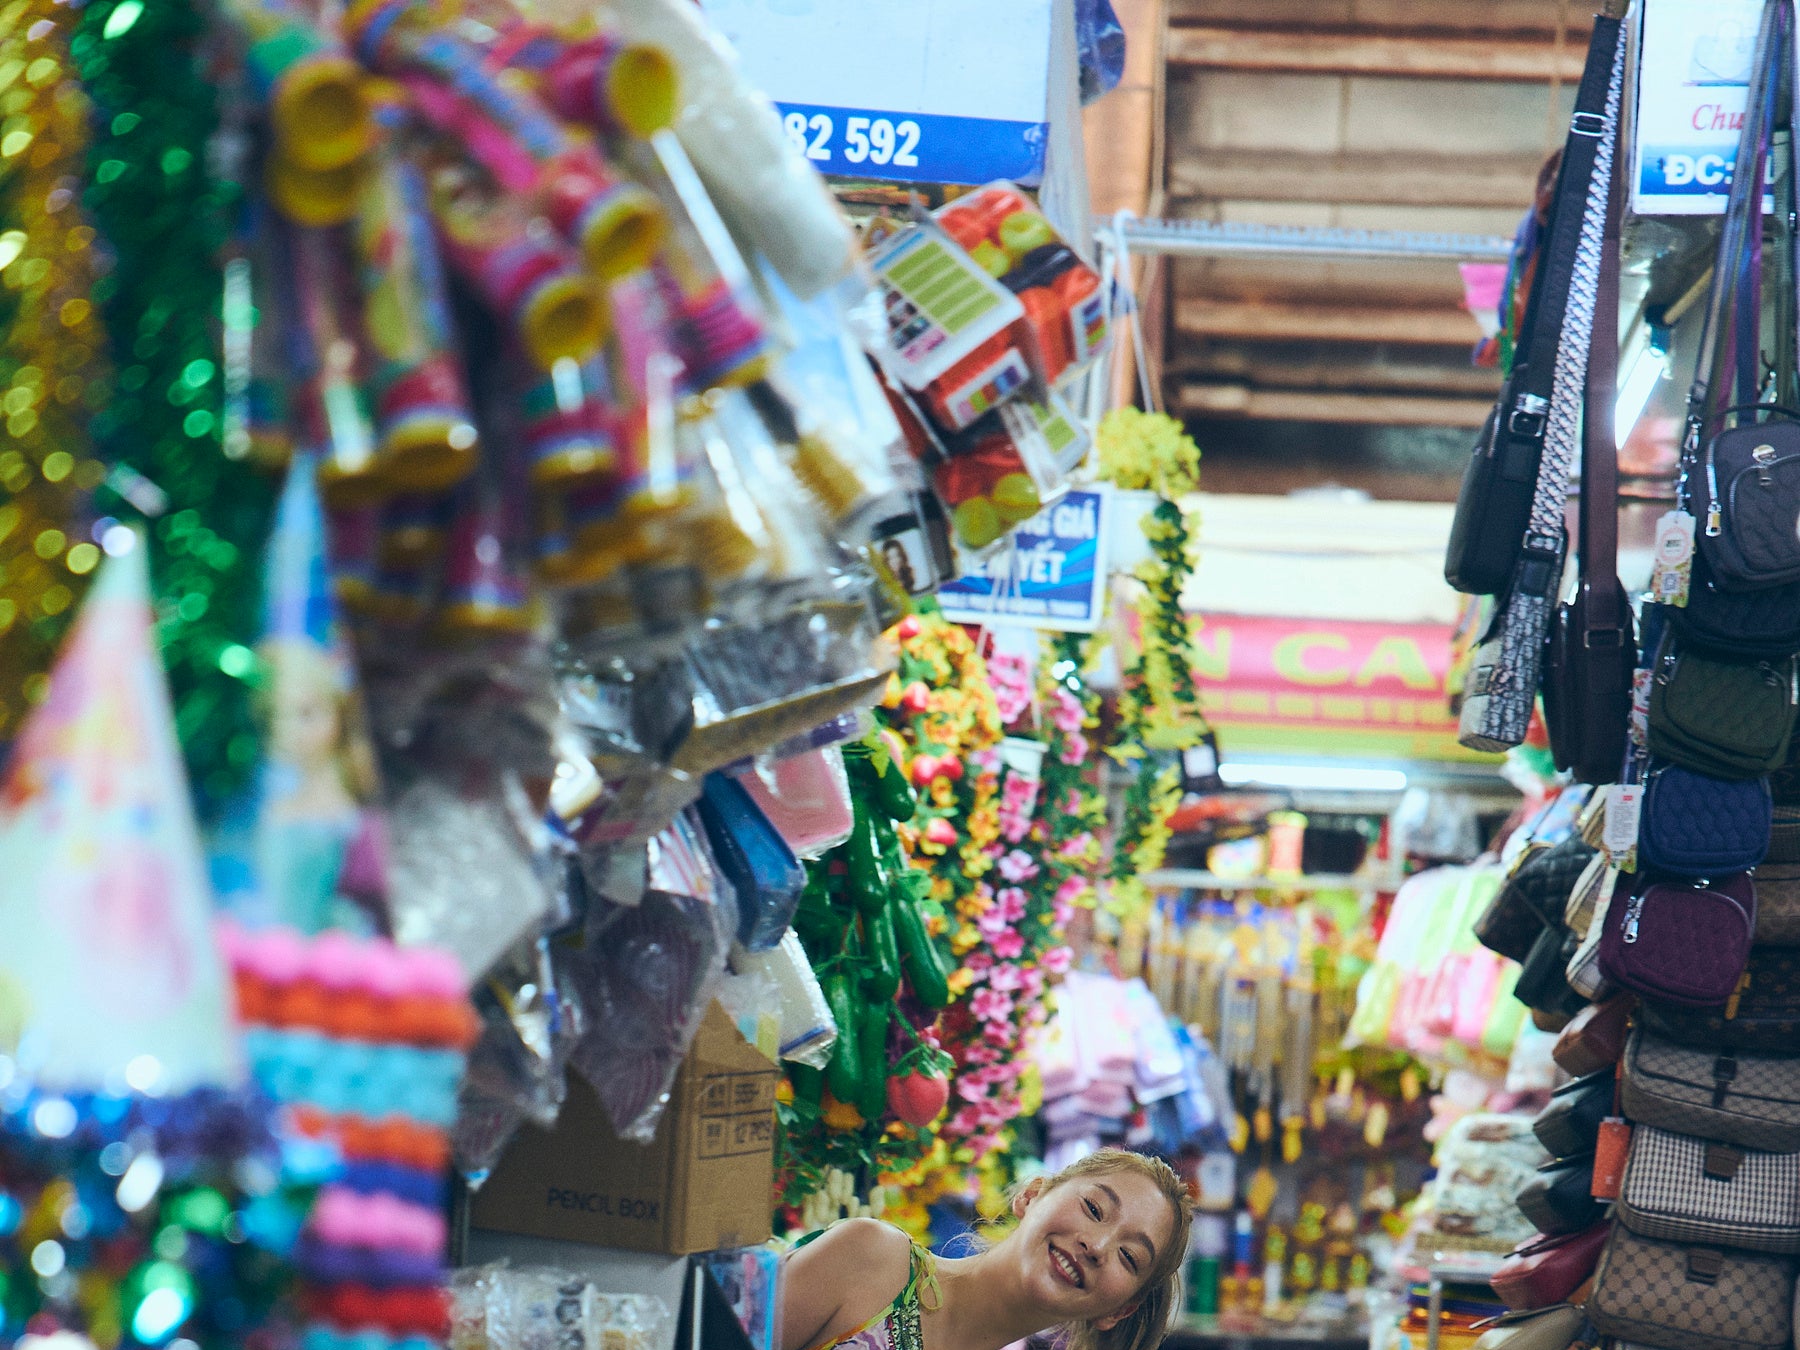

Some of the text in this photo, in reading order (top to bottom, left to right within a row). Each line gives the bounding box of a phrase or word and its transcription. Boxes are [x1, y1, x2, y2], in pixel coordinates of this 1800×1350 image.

[844, 116, 921, 167] 592
[1663, 154, 1733, 186] ĐC:
[546, 1187, 660, 1219] PENCIL BOX
